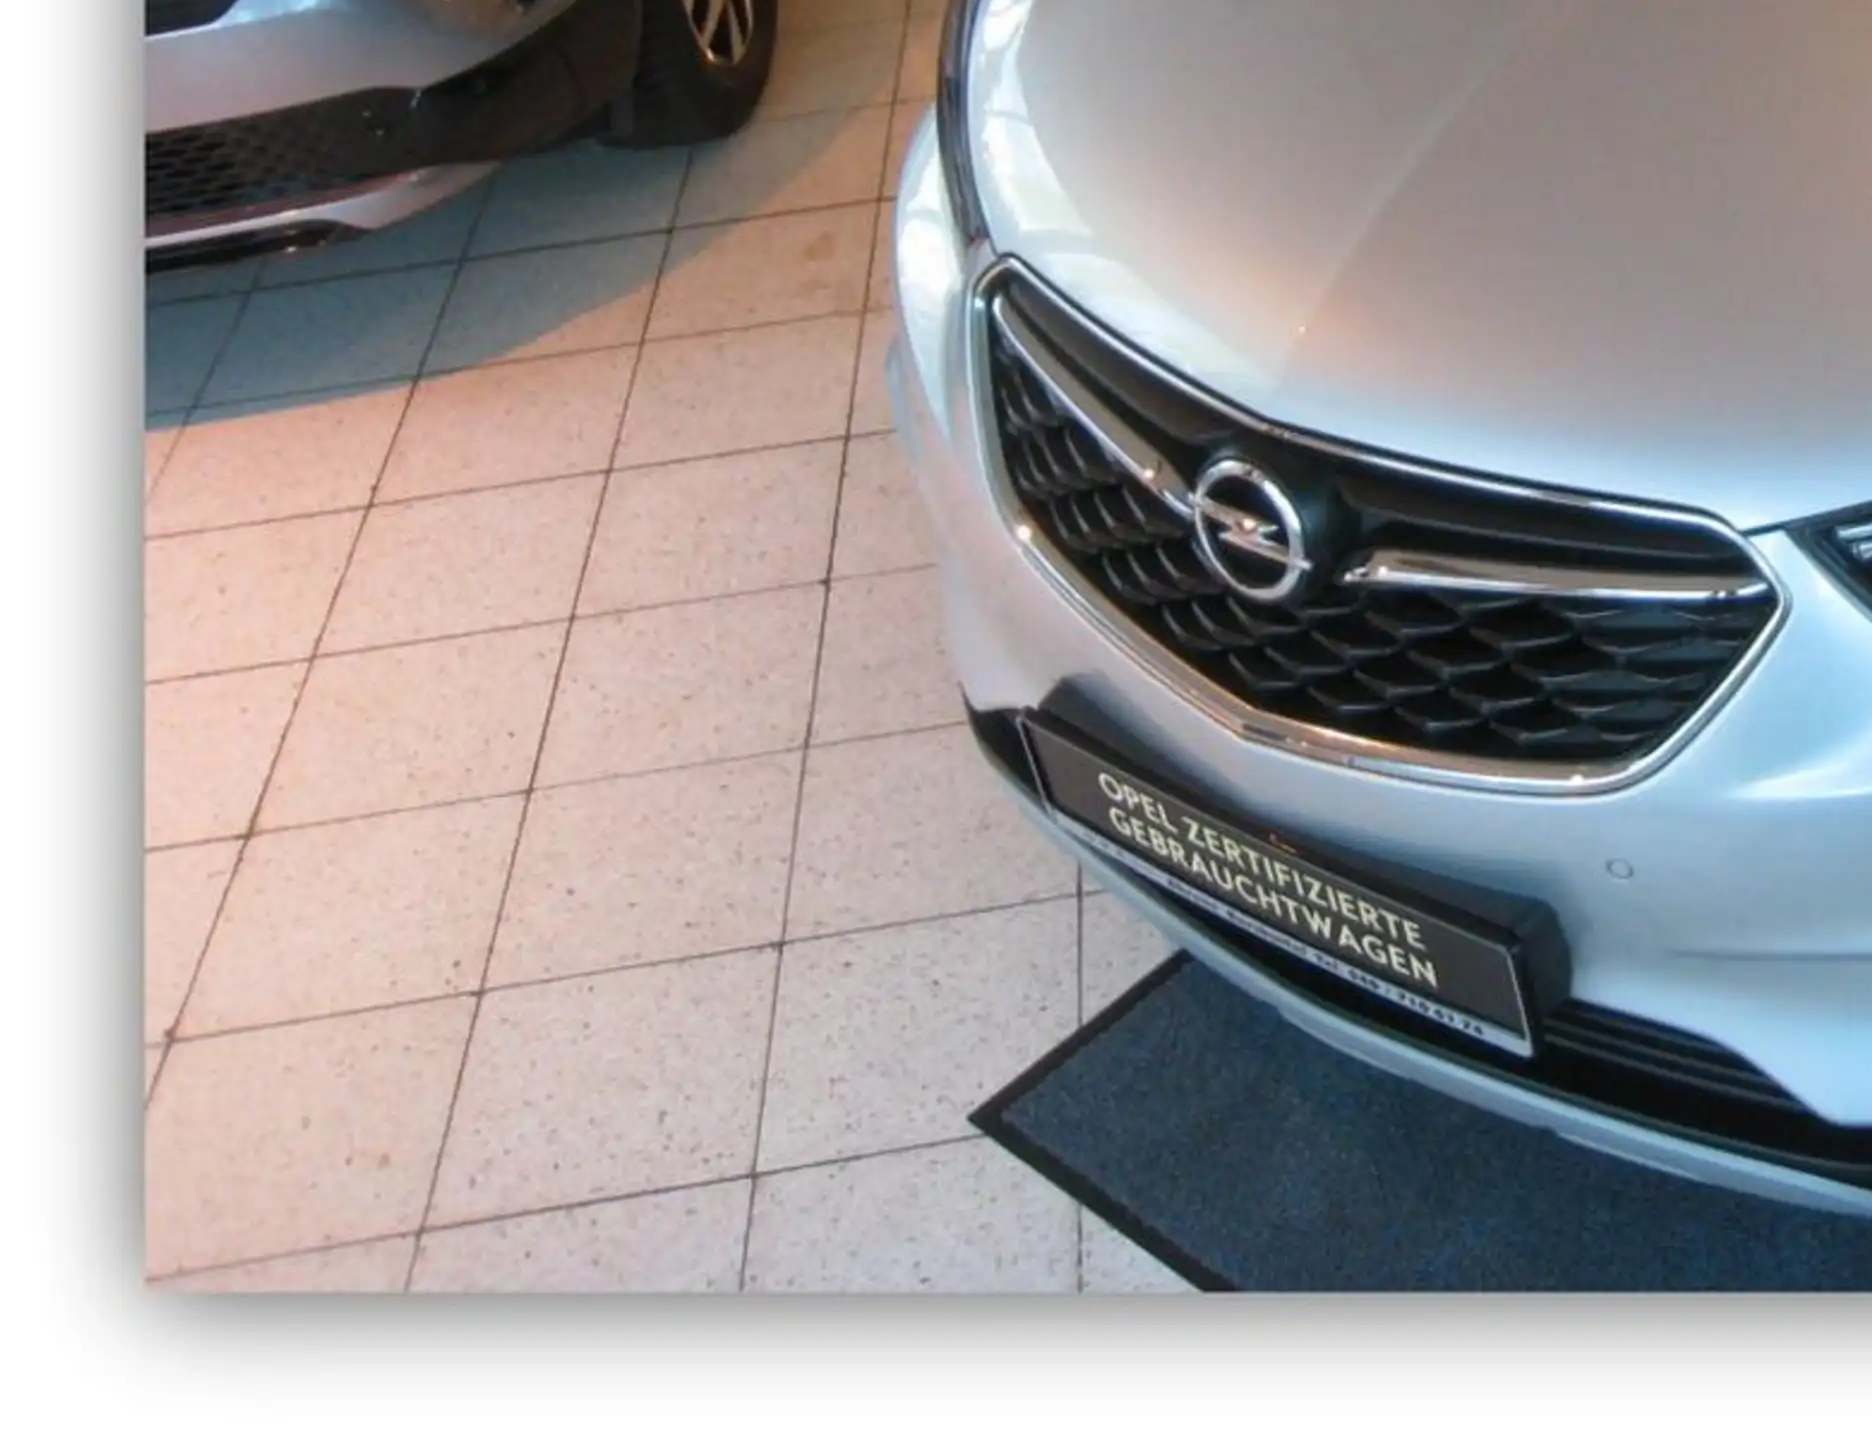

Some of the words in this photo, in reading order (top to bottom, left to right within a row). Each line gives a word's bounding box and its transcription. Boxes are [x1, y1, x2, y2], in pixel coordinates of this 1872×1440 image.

[1098, 771, 1175, 834] OPEL
[1181, 816, 1427, 951] ZERTIFIZIERTE
[1108, 806, 1438, 990] GEBRAUCHTWAGEN
